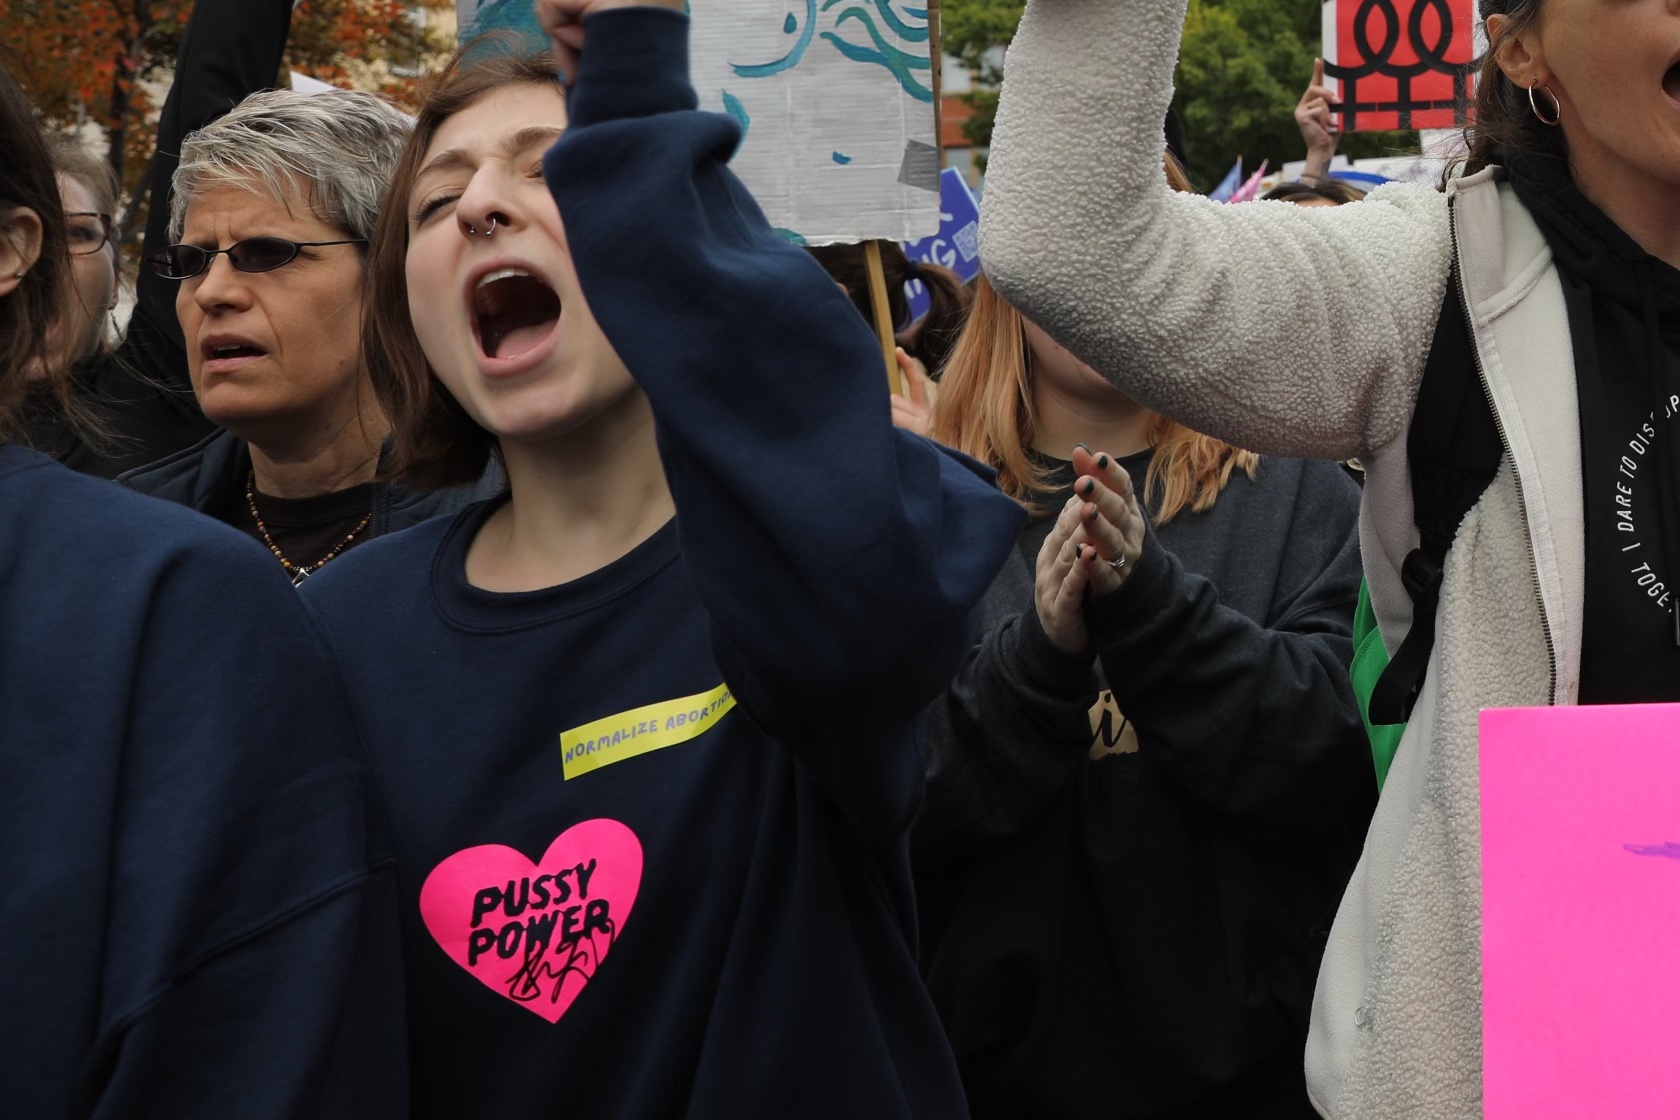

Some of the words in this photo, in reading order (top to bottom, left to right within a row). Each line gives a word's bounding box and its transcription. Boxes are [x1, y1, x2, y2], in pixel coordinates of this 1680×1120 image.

[1619, 455, 1637, 479] TO
[1616, 481, 1635, 533] DARE
[565, 718, 659, 764] NORMALIZE
[470, 857, 598, 929] PUSSY
[468, 898, 612, 967] POWER
